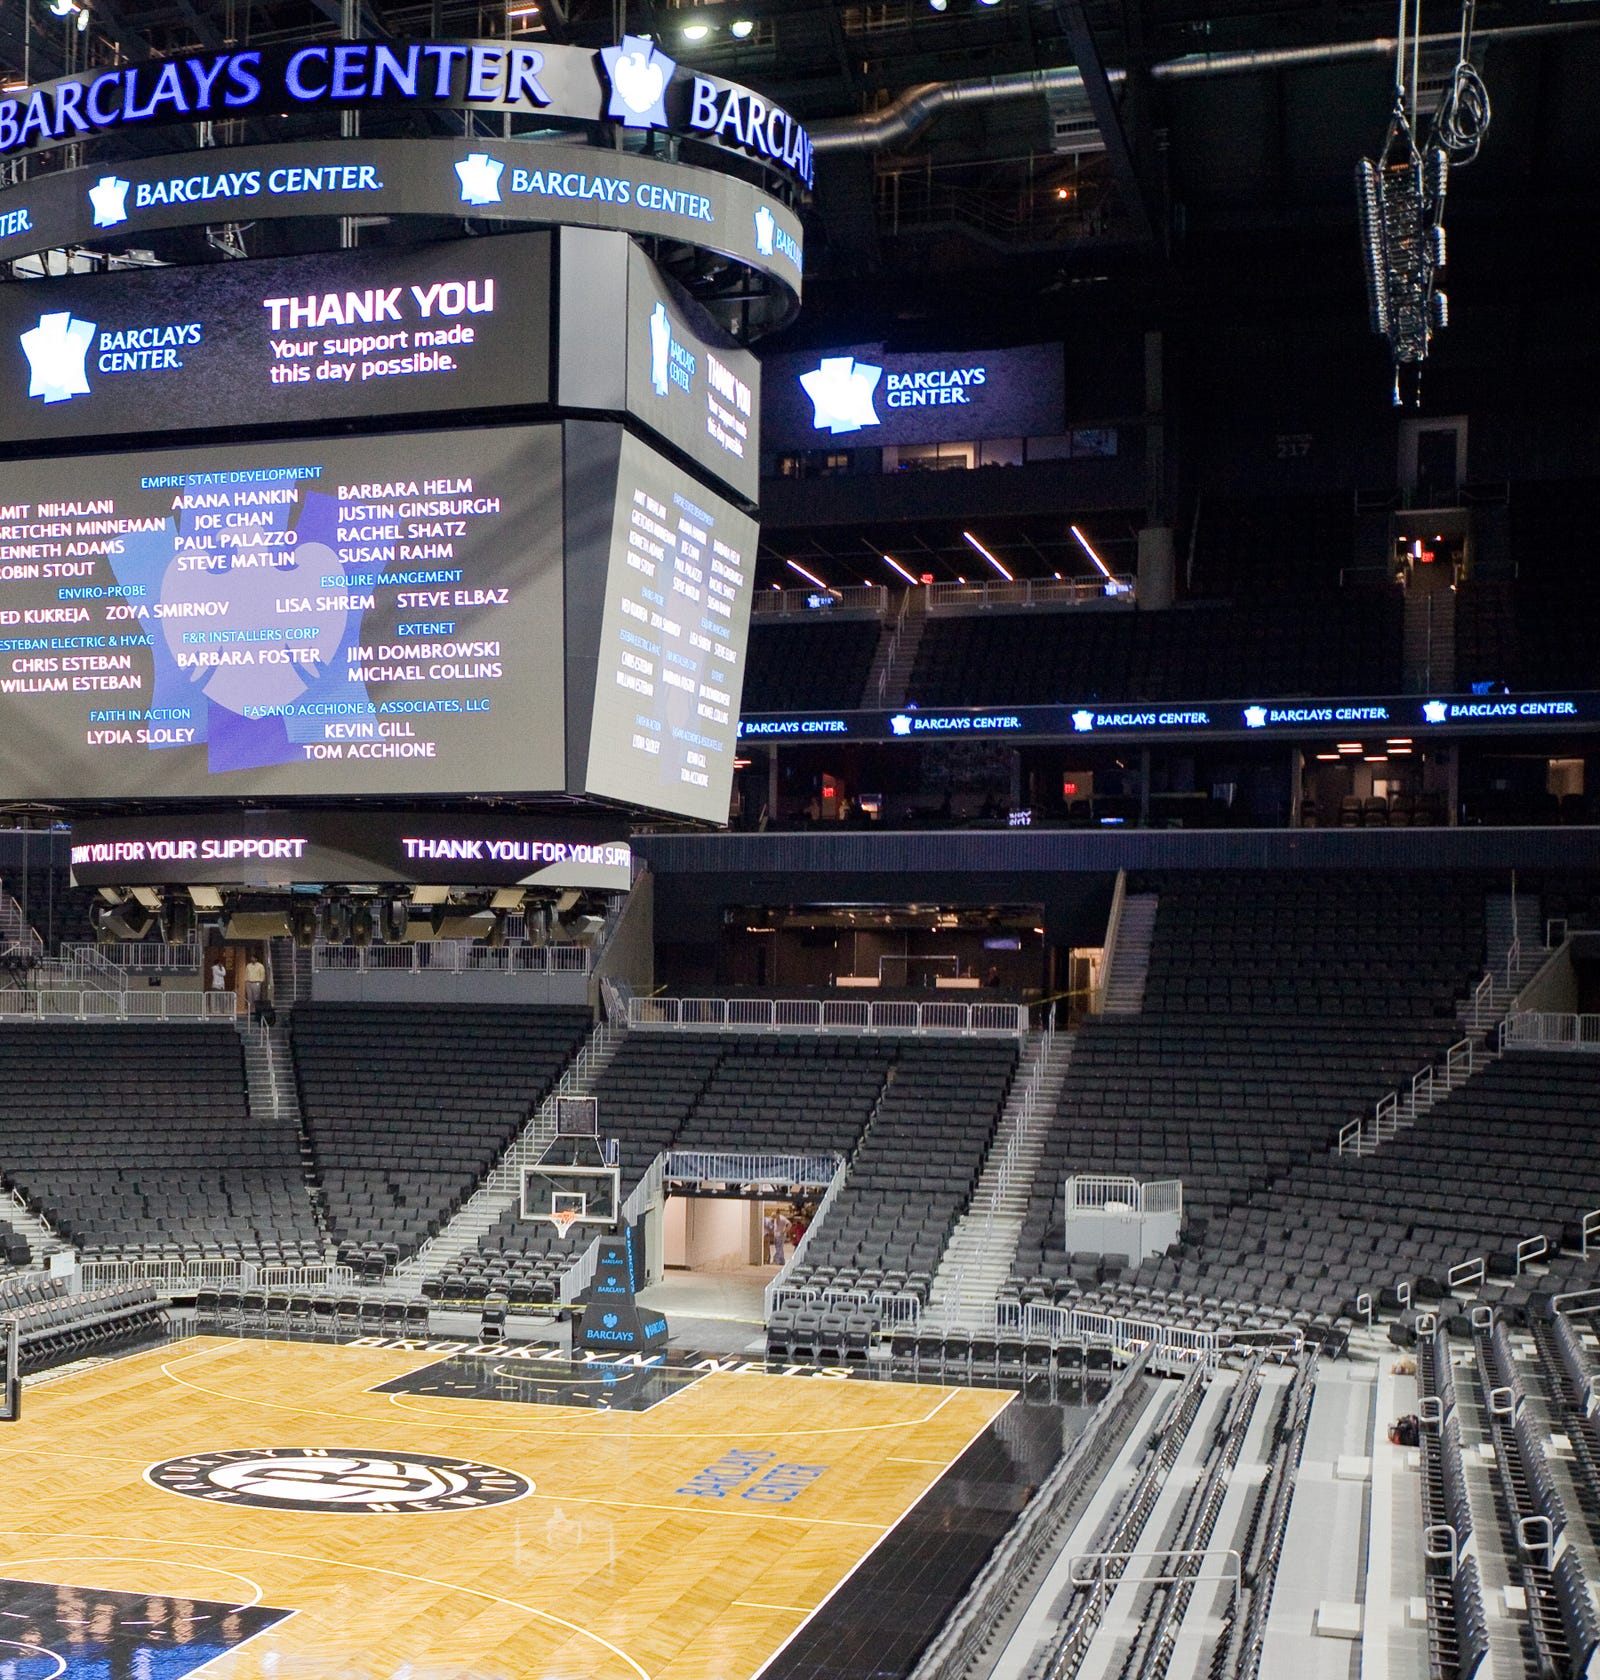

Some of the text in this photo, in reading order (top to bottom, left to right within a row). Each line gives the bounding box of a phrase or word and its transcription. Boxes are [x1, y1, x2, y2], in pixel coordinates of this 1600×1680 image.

[284, 44, 553, 107] CENTER
[136, 171, 261, 208] BARCLAYS
[511, 168, 630, 205] BARCLAYS
[262, 278, 496, 332] THANK YOU
[98, 322, 202, 351] BARCLAYS
[269, 324, 475, 361] Your support made
[270, 350, 458, 385] this day possible.
[887, 367, 986, 391] BARCLAYS
[887, 386, 971, 408] CENTER.
[141, 466, 323, 490] EMPIRE STATE DEVELOPMENT
[171, 488, 299, 510] ARANA HANKIN
[337, 478, 473, 500] BARBARA HELM
[37, 499, 114, 519] NIHALANI
[338, 497, 500, 523] JUSTIN GINSBURGH
[76, 517, 166, 536] MINNEMAN
[194, 511, 274, 531] JOE CHAN
[174, 530, 298, 551] PAUL PALAZZO
[337, 521, 467, 543] RACHEL SHATZ
[65, 539, 125, 556] ADAMS
[338, 543, 453, 564] SUSAN RAHM
[42, 561, 96, 578] STOUT
[177, 551, 295, 572] STEVE MATLIN
[320, 569, 463, 589] ESQUIRE MANGEMENT
[58, 584, 147, 600] ENVIRO-PROBE
[397, 588, 509, 608] STEVE ELBAZ
[105, 601, 229, 621] ZOYA SMIRNOV
[276, 595, 375, 613] LISA SHREM
[24, 607, 90, 624] KUKREJA
[209, 628, 281, 642] INSTALLERS
[285, 627, 320, 640] CORP
[398, 622, 456, 636] EXTENET
[50, 636, 106, 649] ELECTRIC
[108, 635, 117, 646] &
[120, 634, 155, 646] HVAC
[177, 648, 321, 667] BARBARA FOSTER
[347, 641, 500, 663] JIM DOMBROWSKI
[12, 654, 131, 673] CHRIS ESTEBAN
[348, 662, 503, 682] MICHAEL COLLINS
[0, 675, 142, 693] WILLIAM ESTEBAN
[89, 708, 191, 722] FAITH IN ACTION
[243, 699, 490, 717] FASANO ACCHIONE & ASSOCIATES, LLC
[1270, 708, 1332, 721] BARCLAYS
[1450, 703, 1517, 716] BARCLAYS
[87, 727, 195, 745] LYDIA SLOLEY
[324, 721, 415, 739] KEVIN GILL
[746, 721, 799, 733] BARCLAYS
[303, 742, 436, 760] TOM ACCHIONE
[90, 843, 113, 862] YOU
[115, 841, 145, 861] FOR
[147, 840, 197, 860] YOUR
[200, 838, 306, 859] SUPPORT
[402, 838, 483, 859] THANK
[486, 840, 529, 860] YOU
[531, 841, 566, 862] FOR
[568, 843, 604, 864] YOUR
[597, 1284, 626, 1294] BARCLAYS
[587, 1329, 634, 1342] BARCLAYS
[343, 1336, 857, 1381] BROOKLYN NETS
[157, 1446, 330, 1500] BROOKLYN
[674, 1448, 777, 1499] BARCLAYS
[740, 1462, 831, 1503] CENTER
[365, 1461, 520, 1514] NEW YORK
